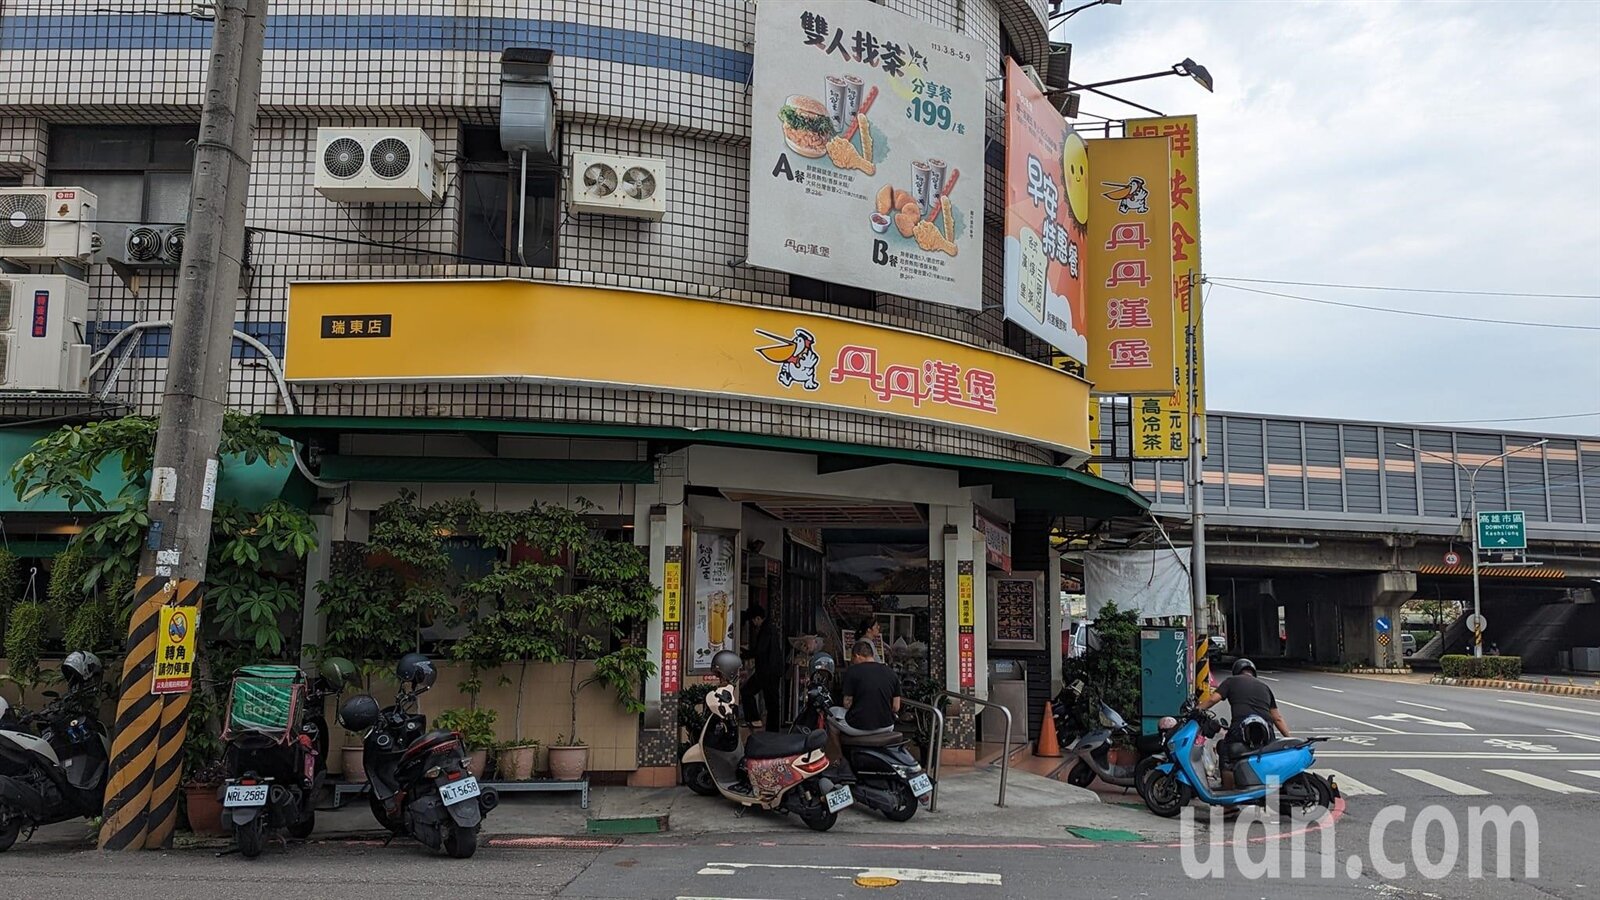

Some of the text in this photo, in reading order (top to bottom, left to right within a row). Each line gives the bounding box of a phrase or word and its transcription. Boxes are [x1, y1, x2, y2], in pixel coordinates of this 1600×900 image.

[800, 10, 906, 77] 雙人找茶
[911, 78, 952, 104] 分享餐
[784, 238, 830, 258] 丹丹漢堡
[1104, 221, 1153, 369] 丹丹漢堡
[331, 319, 382, 334] 瑞東店
[829, 344, 998, 414] 丹丹漢堡
[1141, 398, 1162, 450] 高冷茶
[1480, 513, 1523, 524] 高雄市區
[164, 645, 186, 660] 轉角
[158, 662, 190, 676] 請勿停車
[226, 790, 266, 801] NRL-2585
